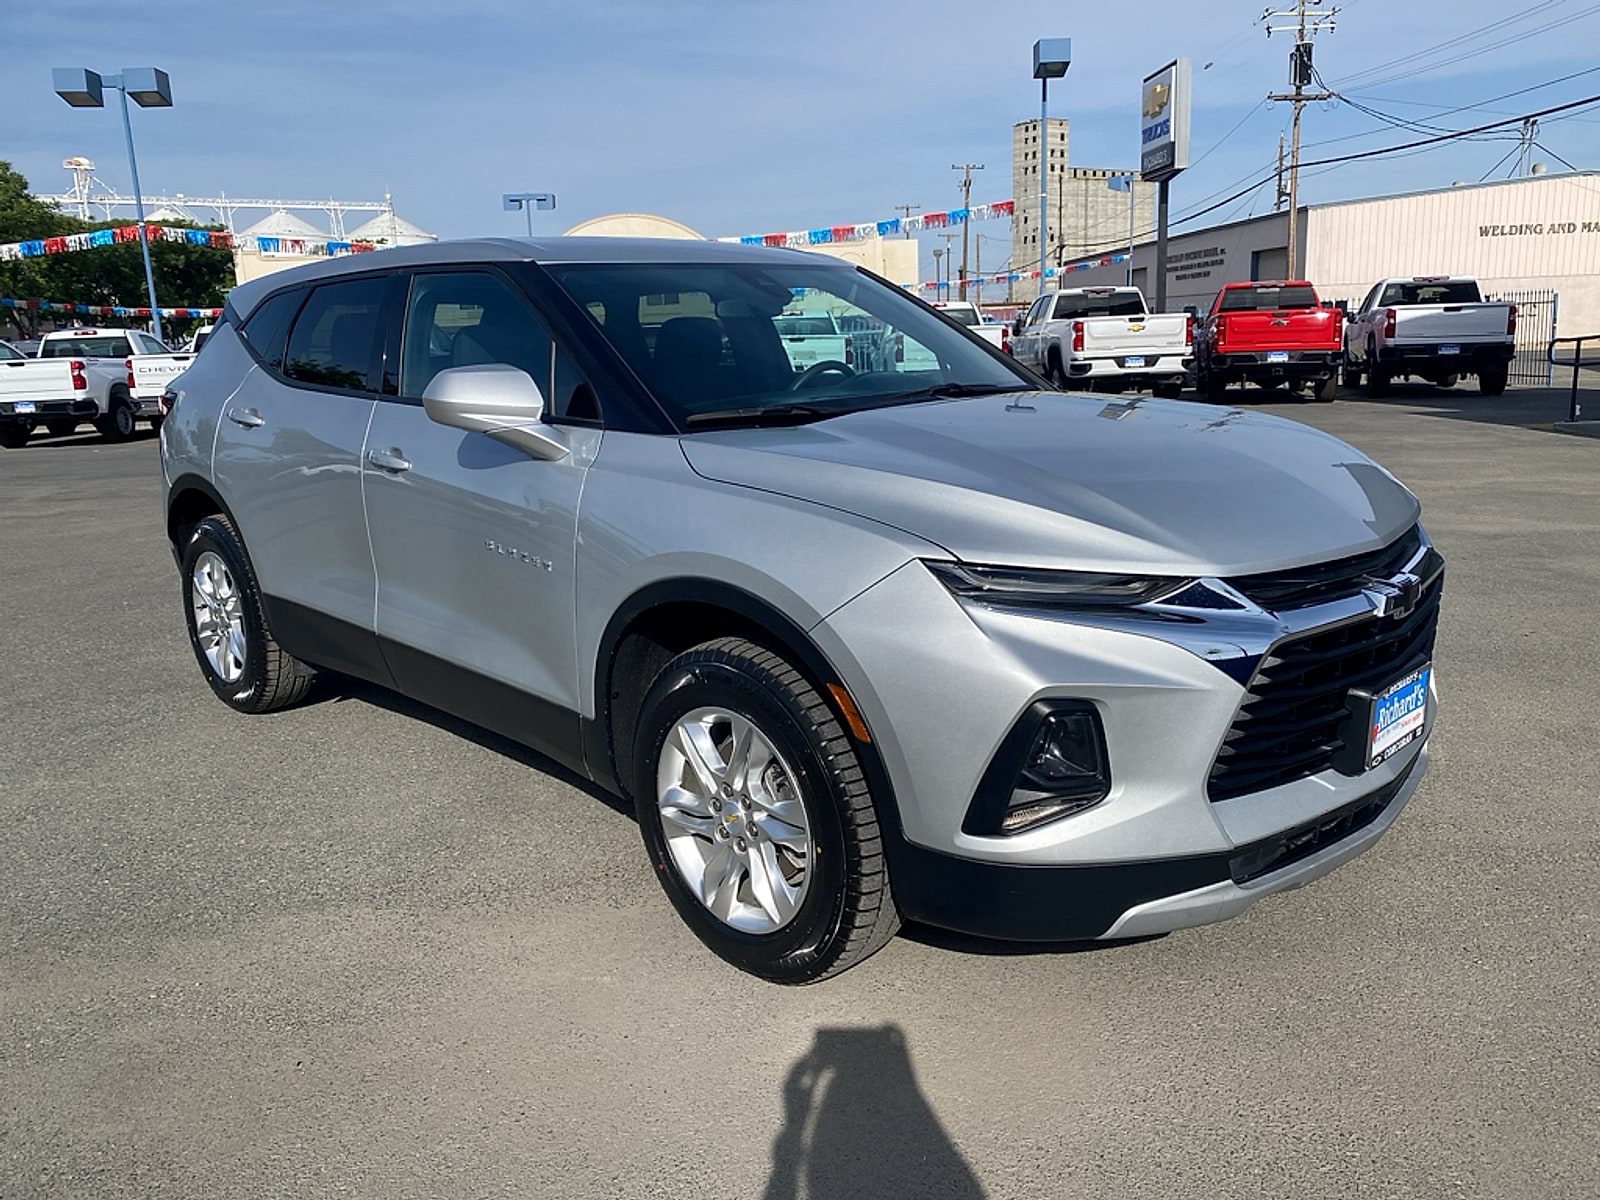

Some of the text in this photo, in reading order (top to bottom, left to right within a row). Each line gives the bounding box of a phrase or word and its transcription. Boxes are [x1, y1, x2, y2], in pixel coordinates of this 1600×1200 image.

[1479, 223, 1543, 237] WELDING
[1547, 222, 1577, 235] AND
[484, 539, 553, 572] BLAZER
[1379, 683, 1425, 729] Richard's
